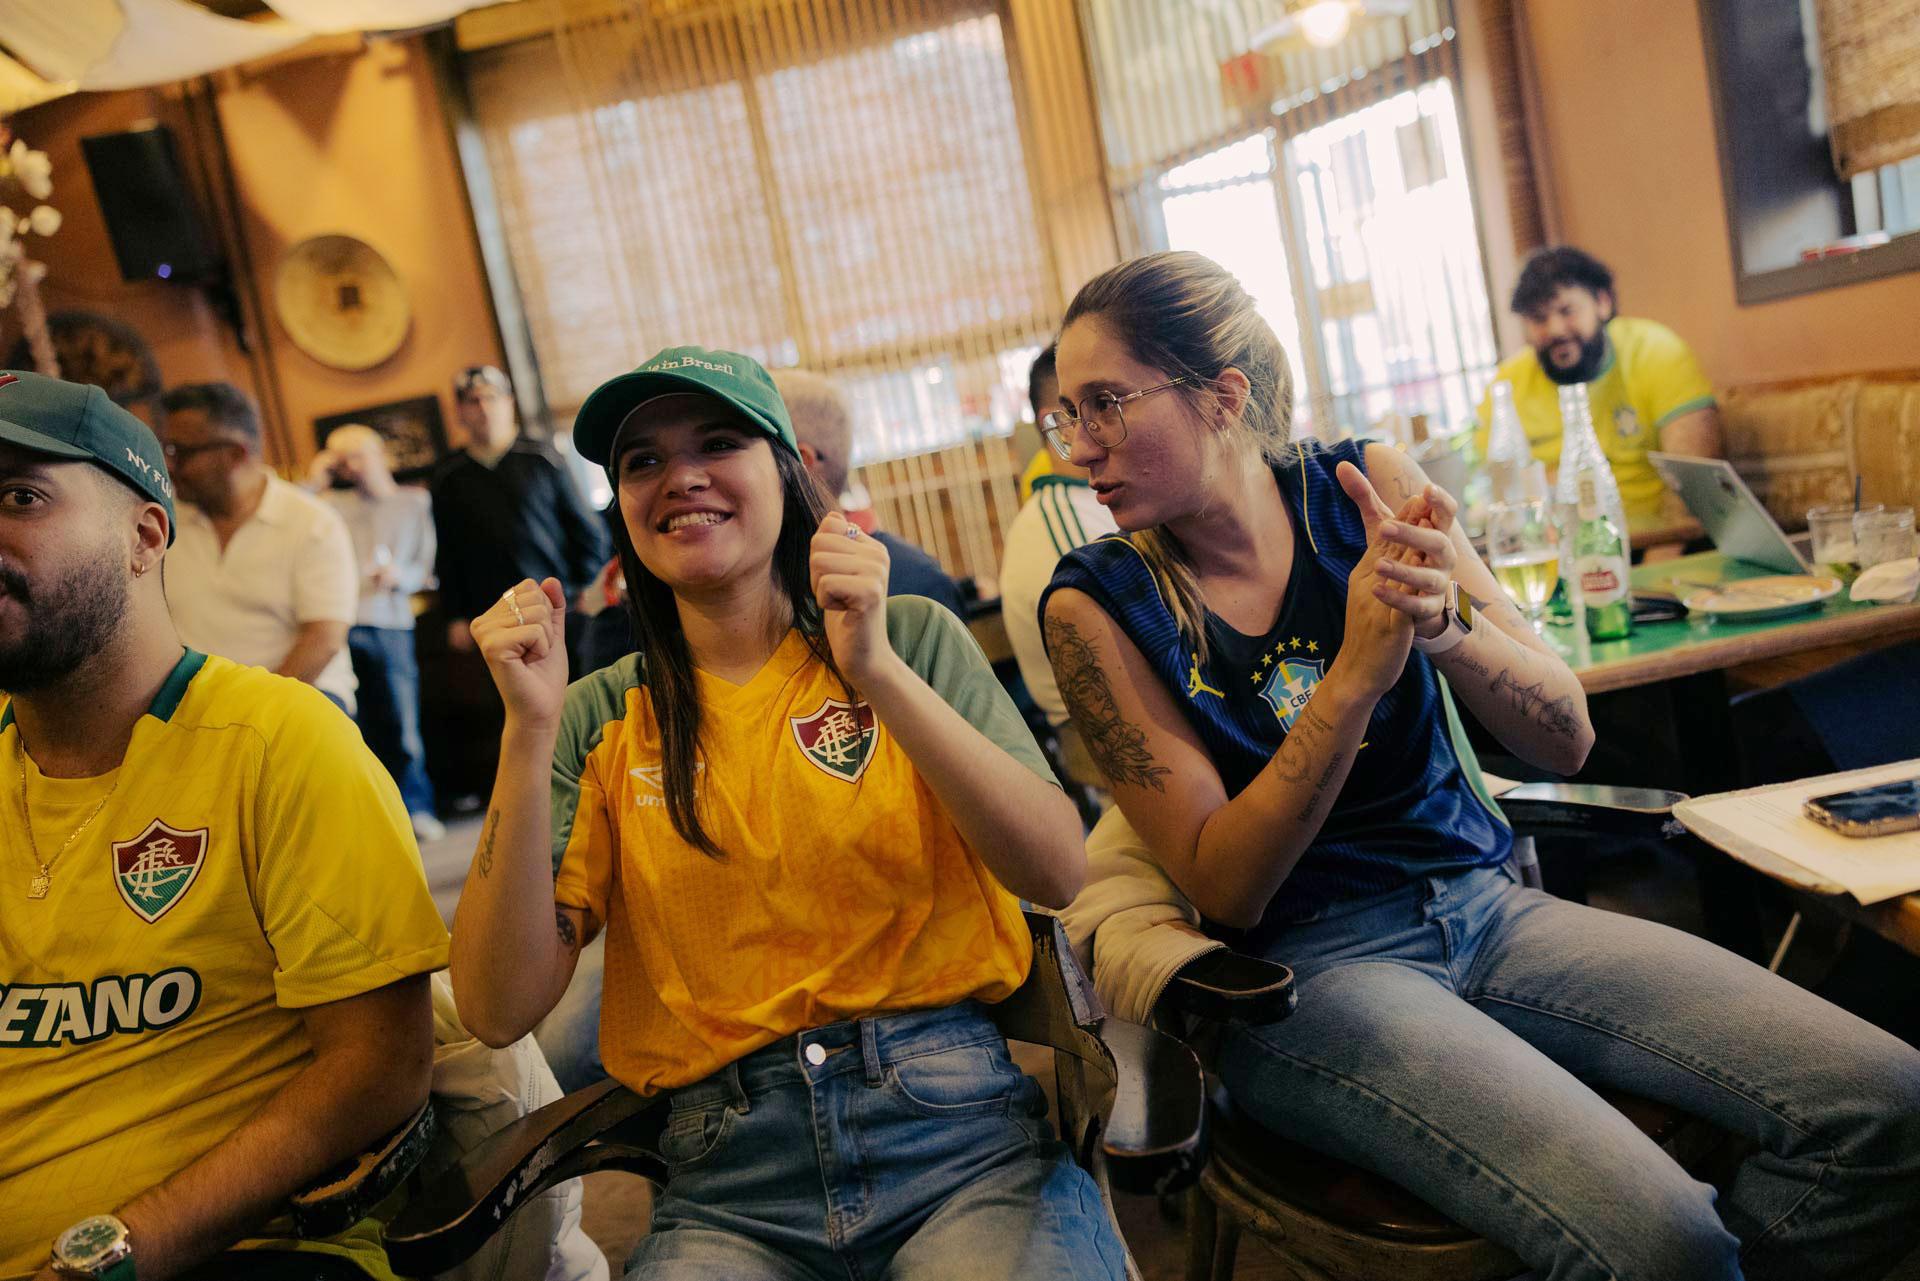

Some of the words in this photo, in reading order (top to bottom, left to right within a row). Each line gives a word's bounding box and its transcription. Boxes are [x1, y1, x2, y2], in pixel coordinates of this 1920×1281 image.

[661, 360, 680, 369] in
[681, 356, 735, 376] Brazil
[126, 448, 151, 474] NY
[1290, 689, 1312, 708] CBF
[0, 971, 198, 1042] ETANO
